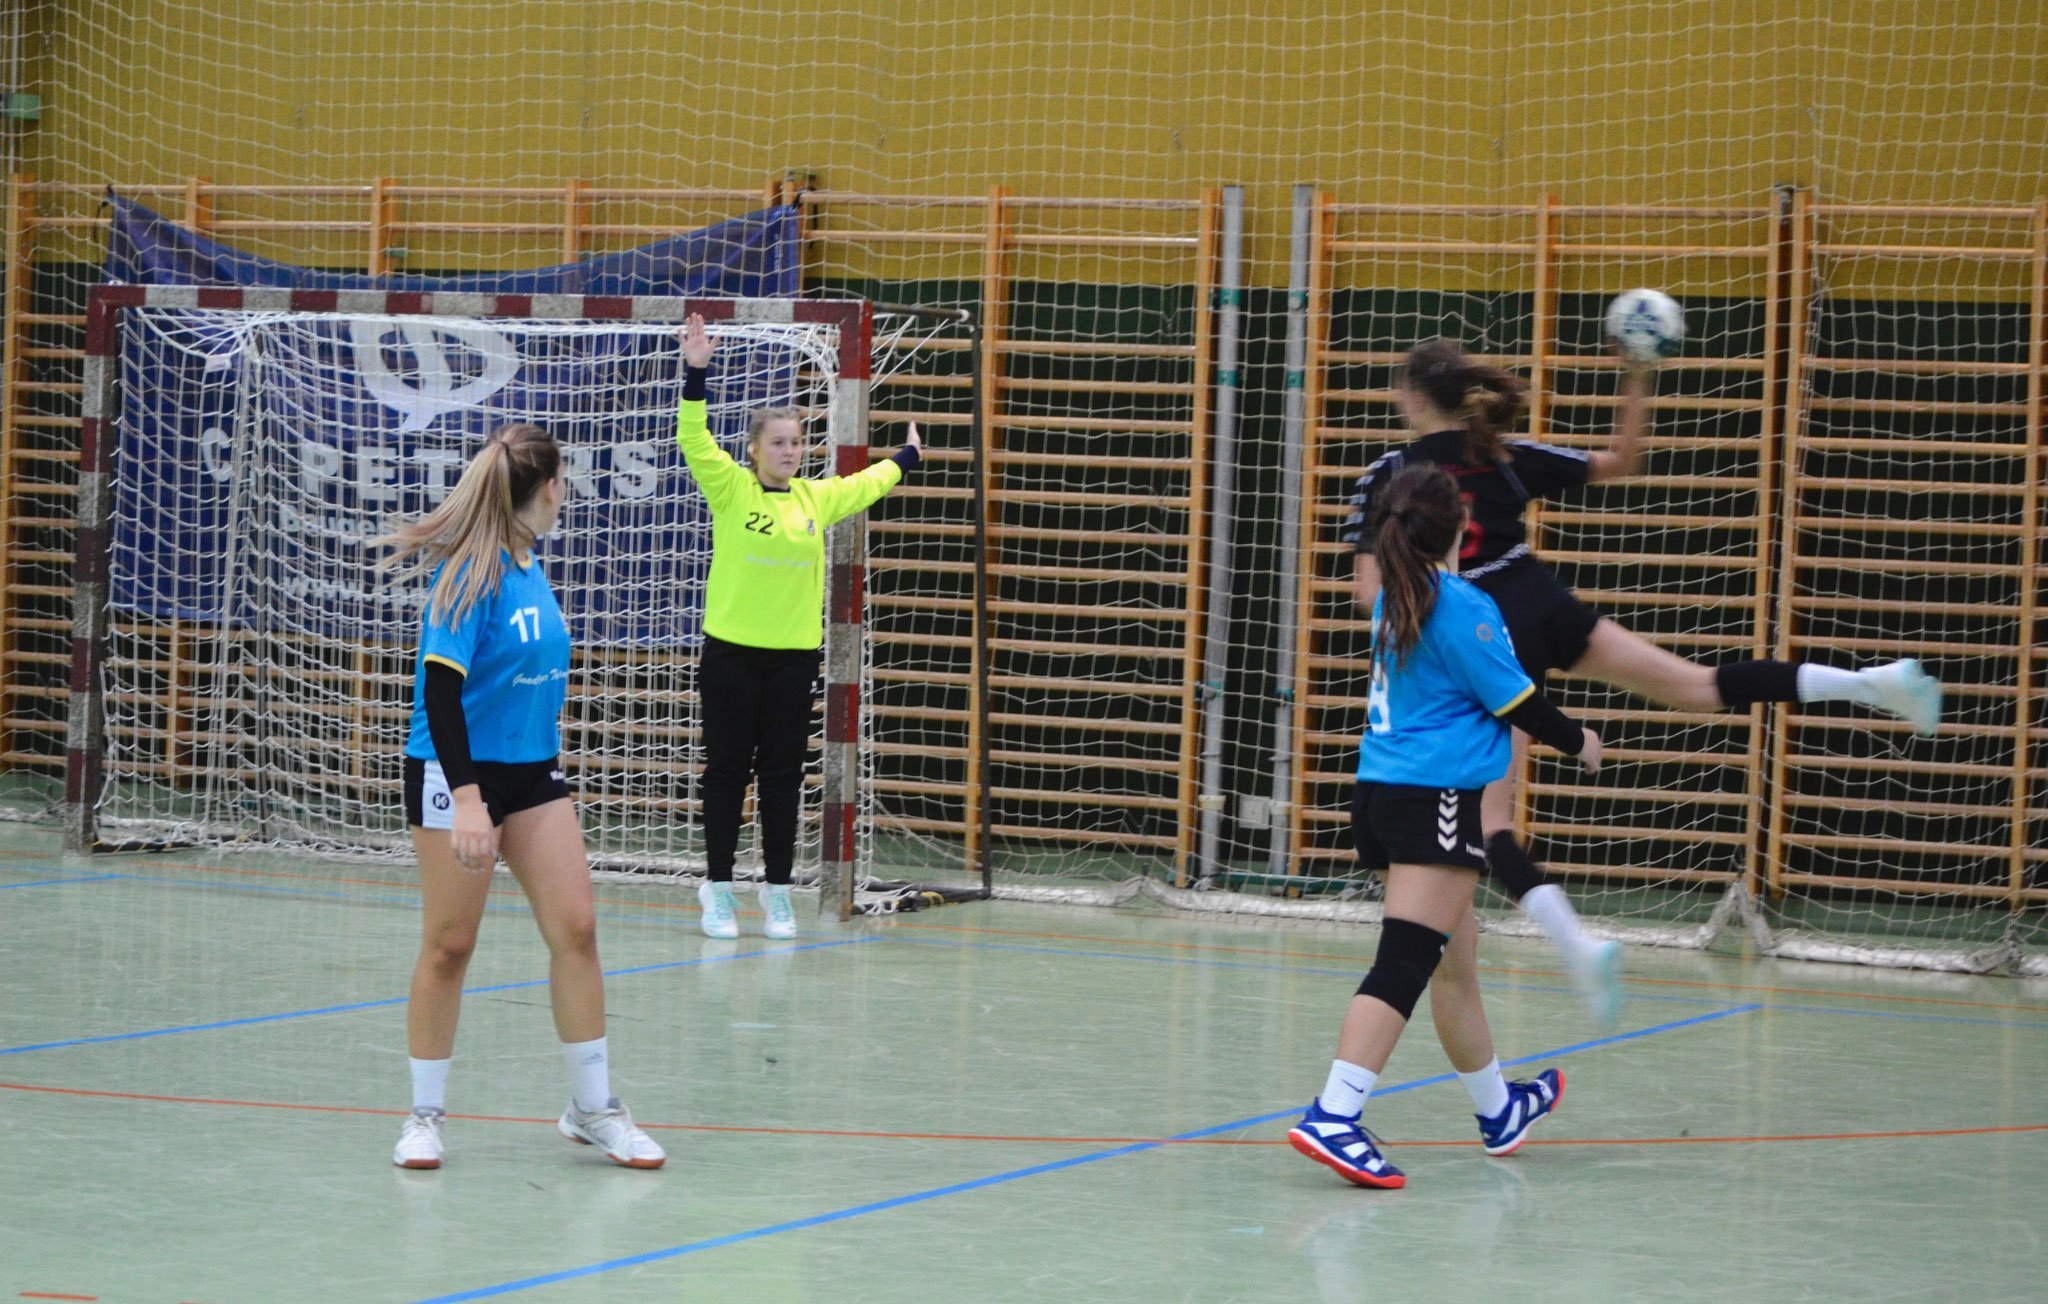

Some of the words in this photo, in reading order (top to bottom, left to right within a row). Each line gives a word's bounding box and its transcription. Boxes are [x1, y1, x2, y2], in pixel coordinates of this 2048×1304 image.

[301, 442, 658, 502] PETRS
[745, 511, 774, 536] 22
[509, 606, 541, 644] 17
